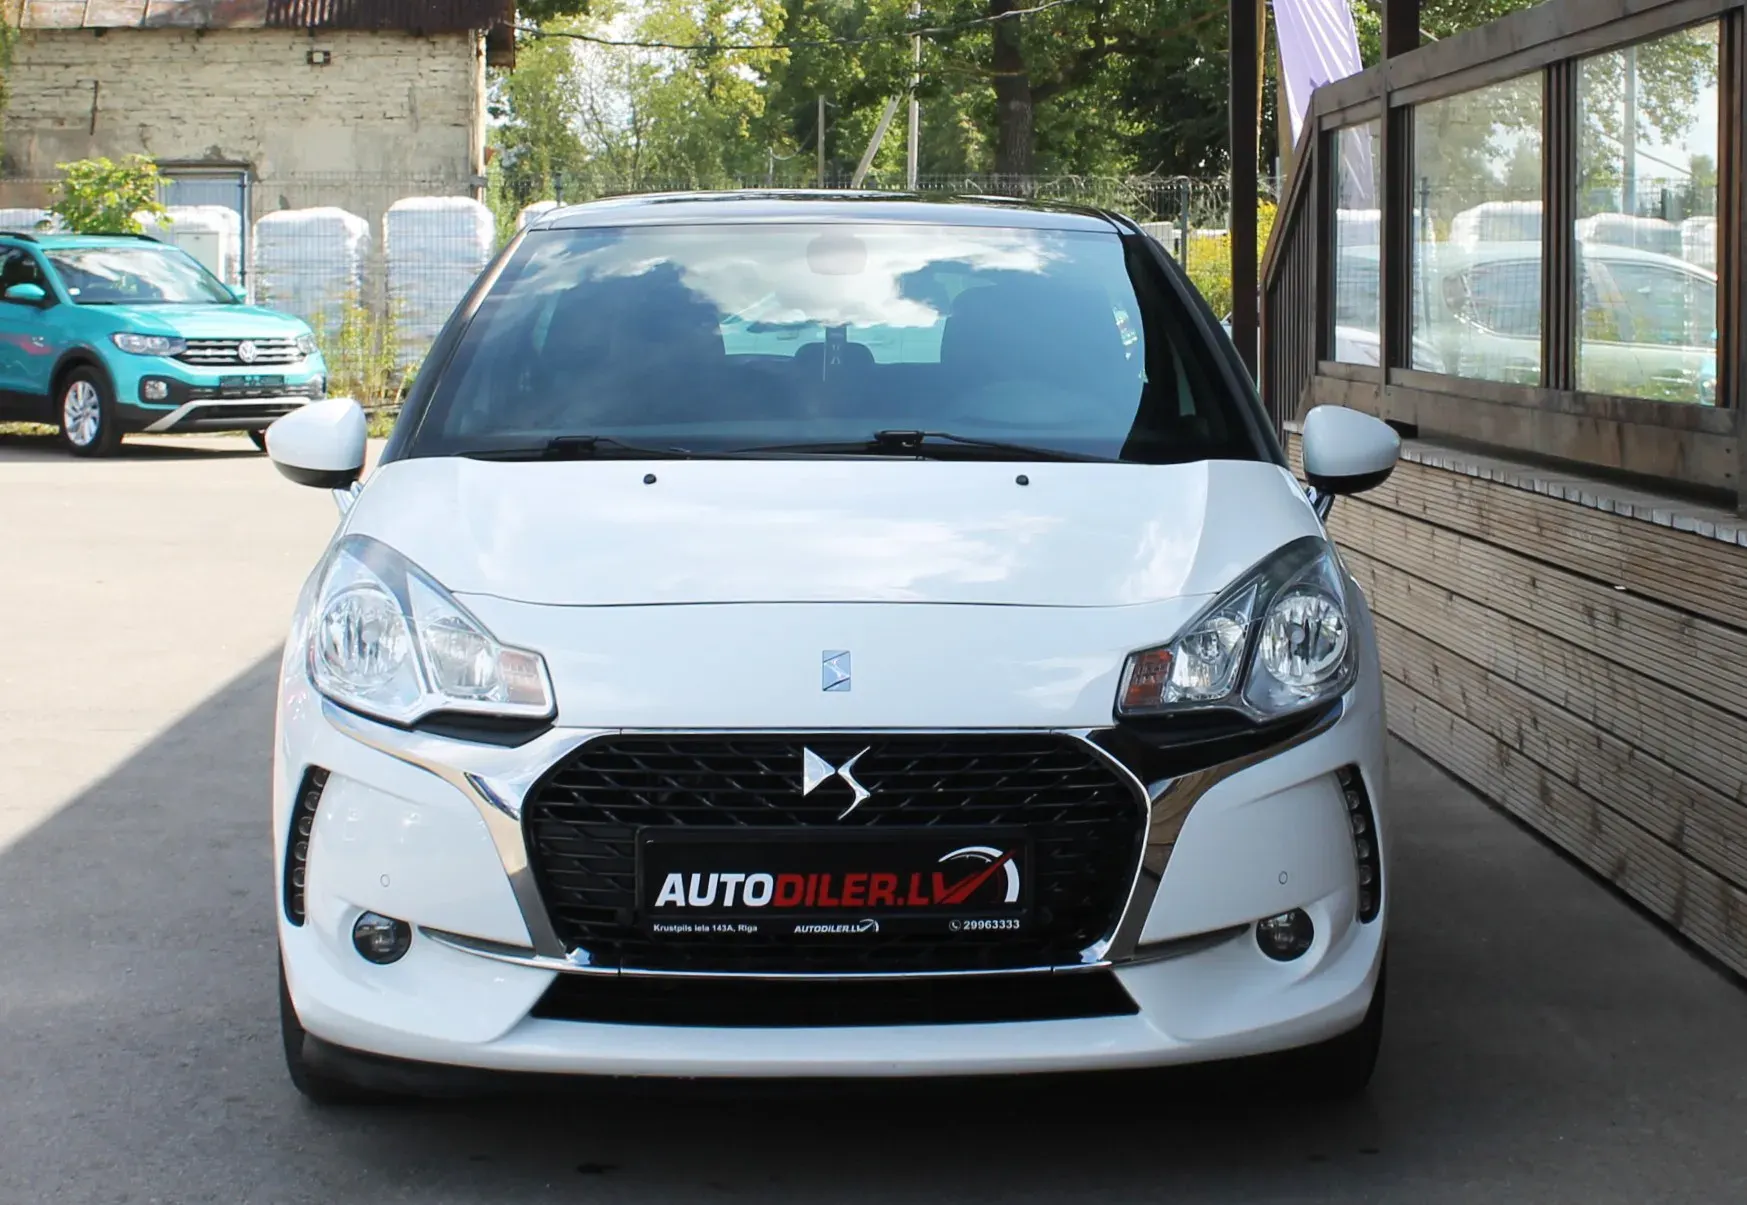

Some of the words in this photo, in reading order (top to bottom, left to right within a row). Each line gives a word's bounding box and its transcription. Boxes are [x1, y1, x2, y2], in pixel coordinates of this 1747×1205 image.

[654, 872, 986, 907] AUTODILER.LV
[653, 923, 692, 933] Krustpils
[712, 923, 736, 933] 143A,
[794, 924, 868, 934] AUTODILER.LV
[963, 919, 1020, 930] 29963333
